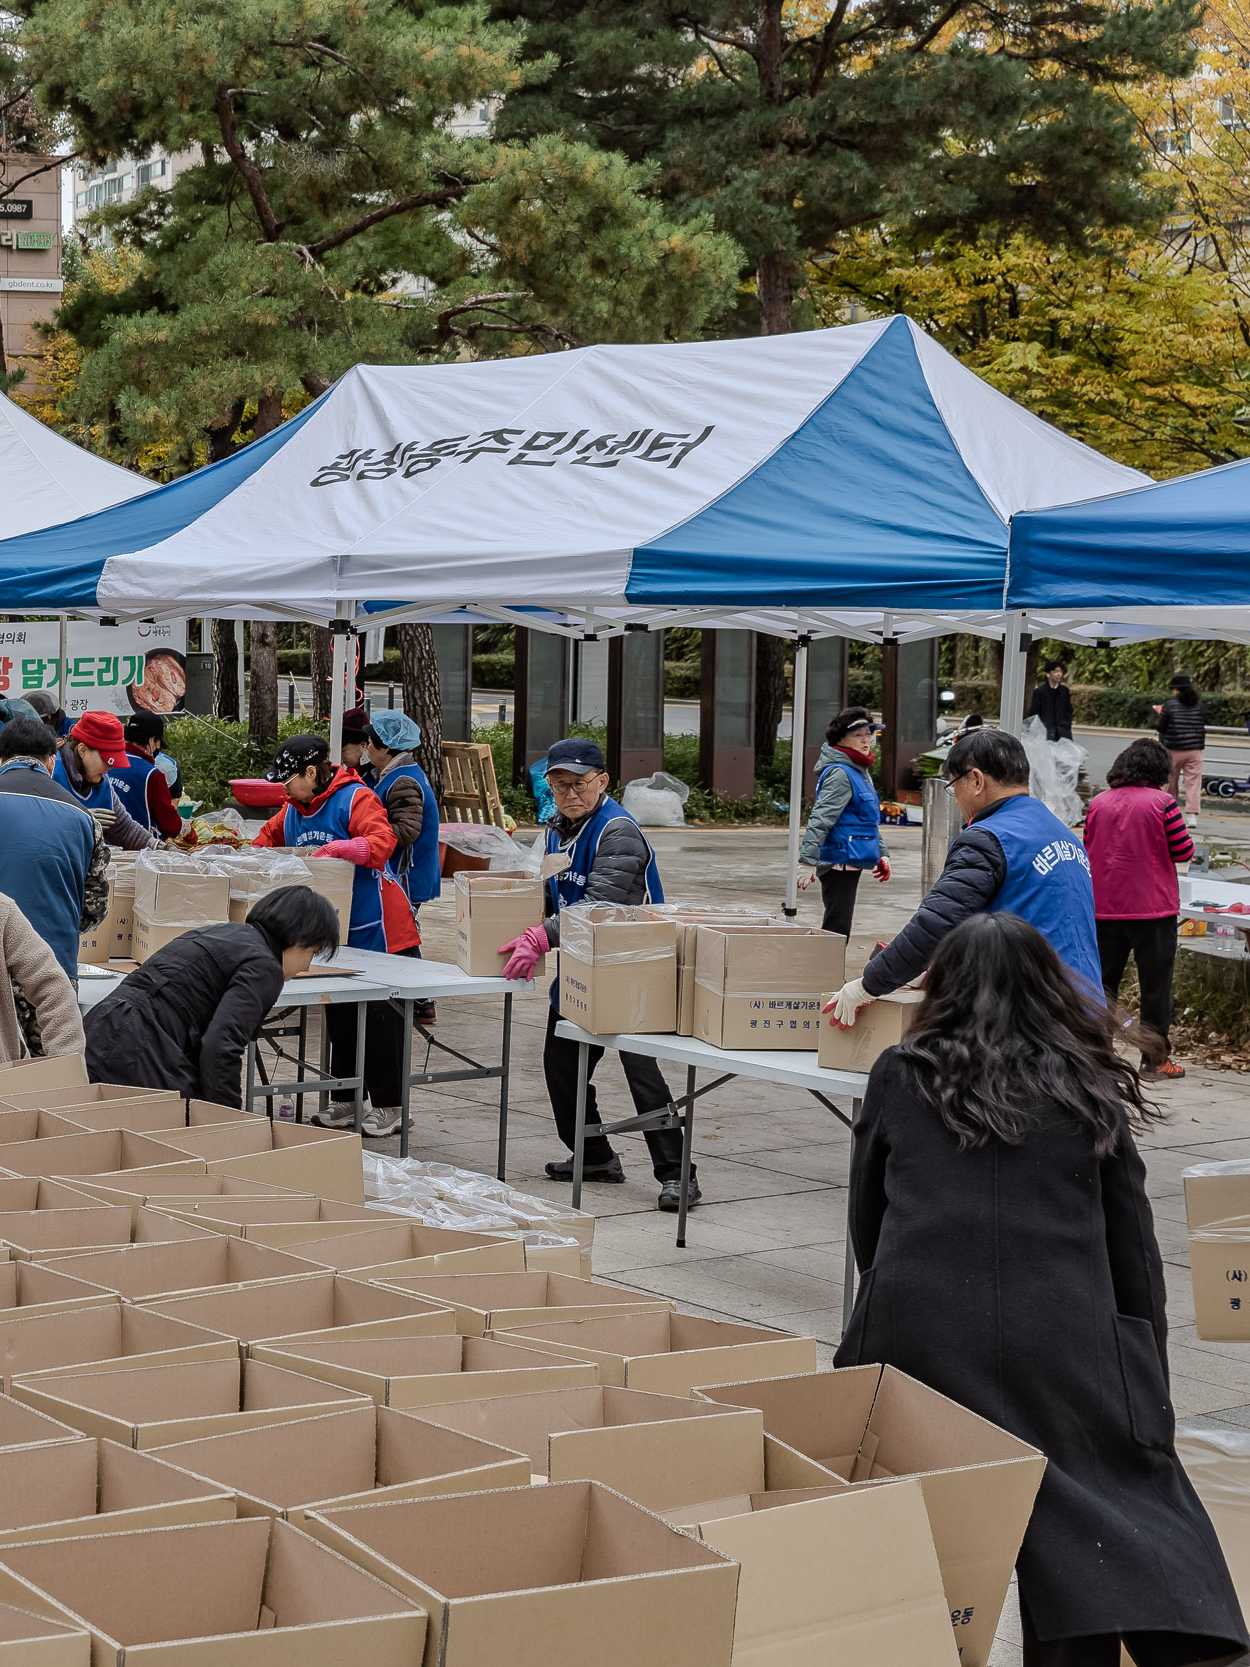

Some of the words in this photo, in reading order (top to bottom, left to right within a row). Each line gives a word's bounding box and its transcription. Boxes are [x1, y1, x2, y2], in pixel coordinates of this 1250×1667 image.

[8, 281, 54, 289] gbdent.co.kr
[309, 425, 716, 488] 광장동주민센터
[21, 655, 145, 690] 담가드리기
[71, 698, 89, 711] 광장
[750, 1001, 765, 1009] (사)
[1225, 1269, 1248, 1283] (사)
